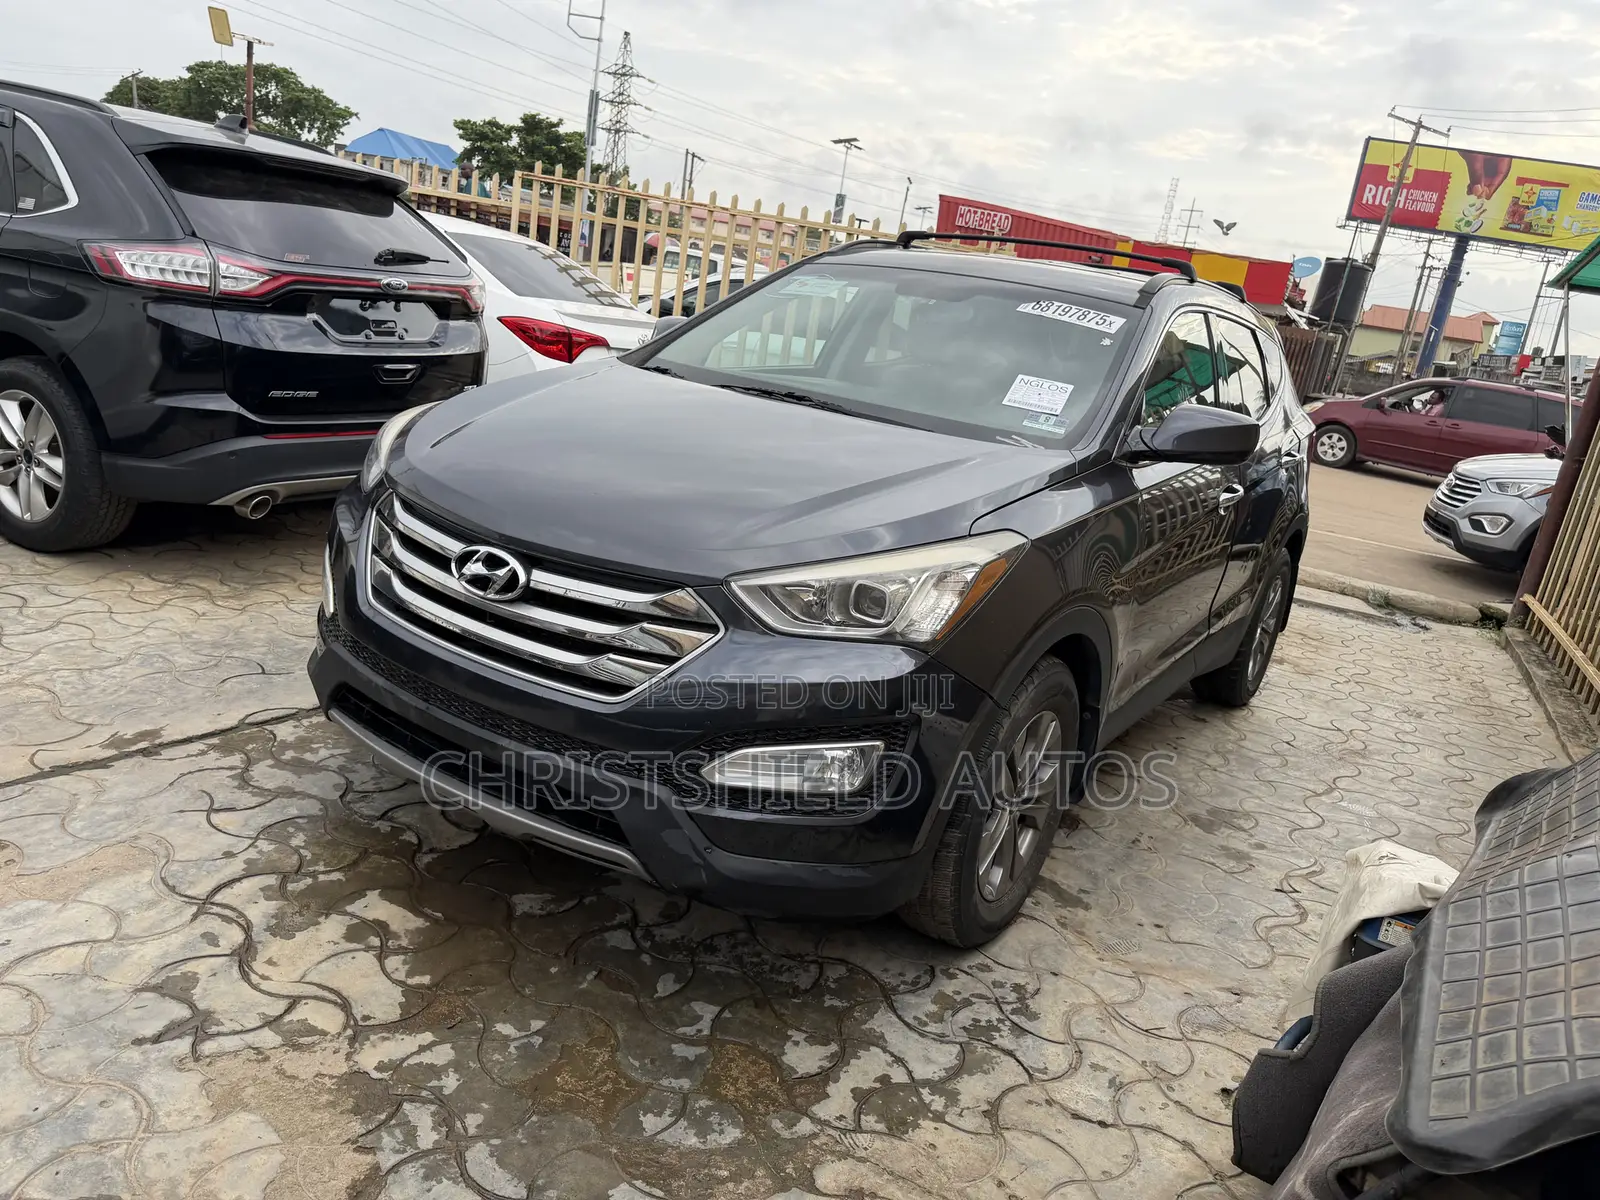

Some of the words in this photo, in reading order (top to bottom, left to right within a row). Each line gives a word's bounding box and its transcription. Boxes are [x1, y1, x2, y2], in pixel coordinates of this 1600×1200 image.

[1362, 183, 1407, 209] RICH
[1407, 188, 1439, 203] CHICKEN
[1405, 199, 1436, 214] FLAVOUR
[1018, 377, 1069, 394] NGLOS
[268, 390, 319, 398] EDGE
